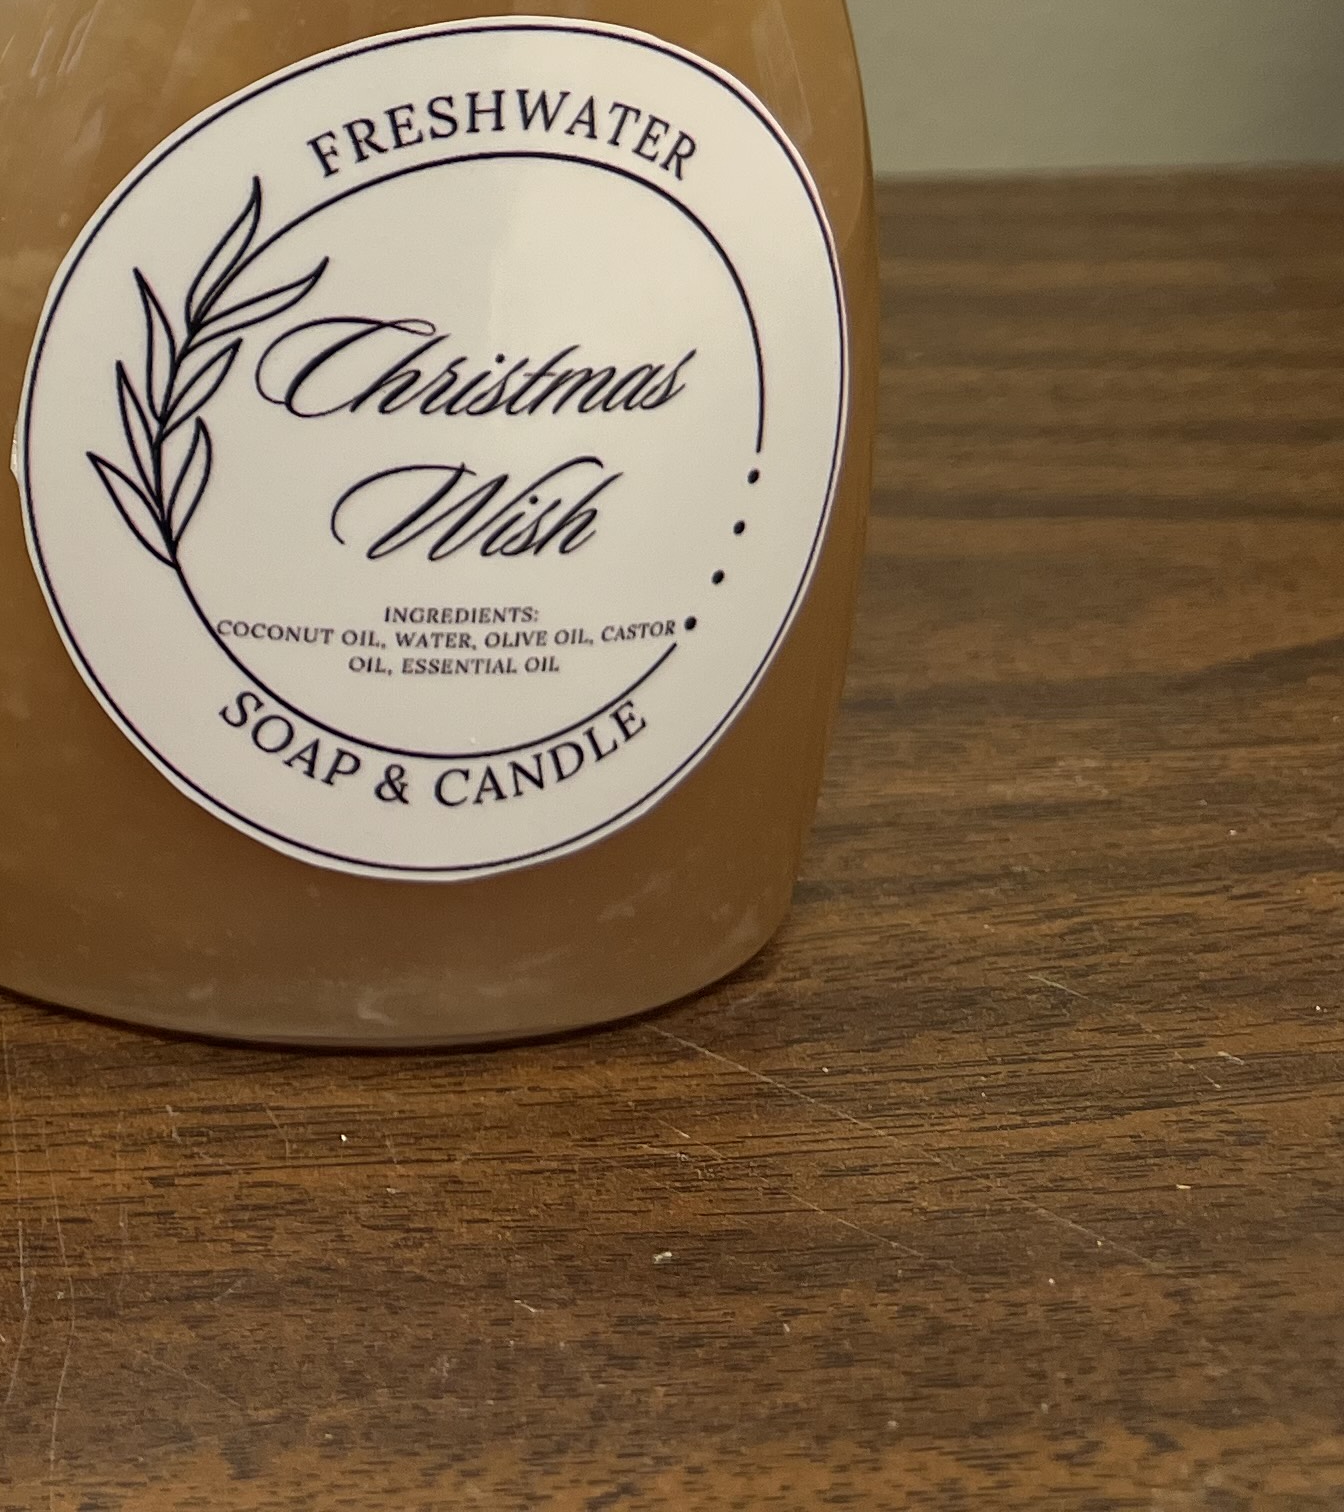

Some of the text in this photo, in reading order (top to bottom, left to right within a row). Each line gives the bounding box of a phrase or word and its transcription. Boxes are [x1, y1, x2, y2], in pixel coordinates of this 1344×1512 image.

[305, 88, 699, 180] FRESHWATER
[255, 317, 698, 418] Christmas
[331, 455, 624, 561] Wish
[216, 619, 677, 650] COCONUT OIL, WATER, OLIVE OIL, CASTOR
[383, 605, 539, 624] INGREDIENTS:
[347, 655, 393, 675] OIL,
[400, 656, 518, 675] ESSENTIAL
[218, 690, 648, 808] SOAP & CANDLE
